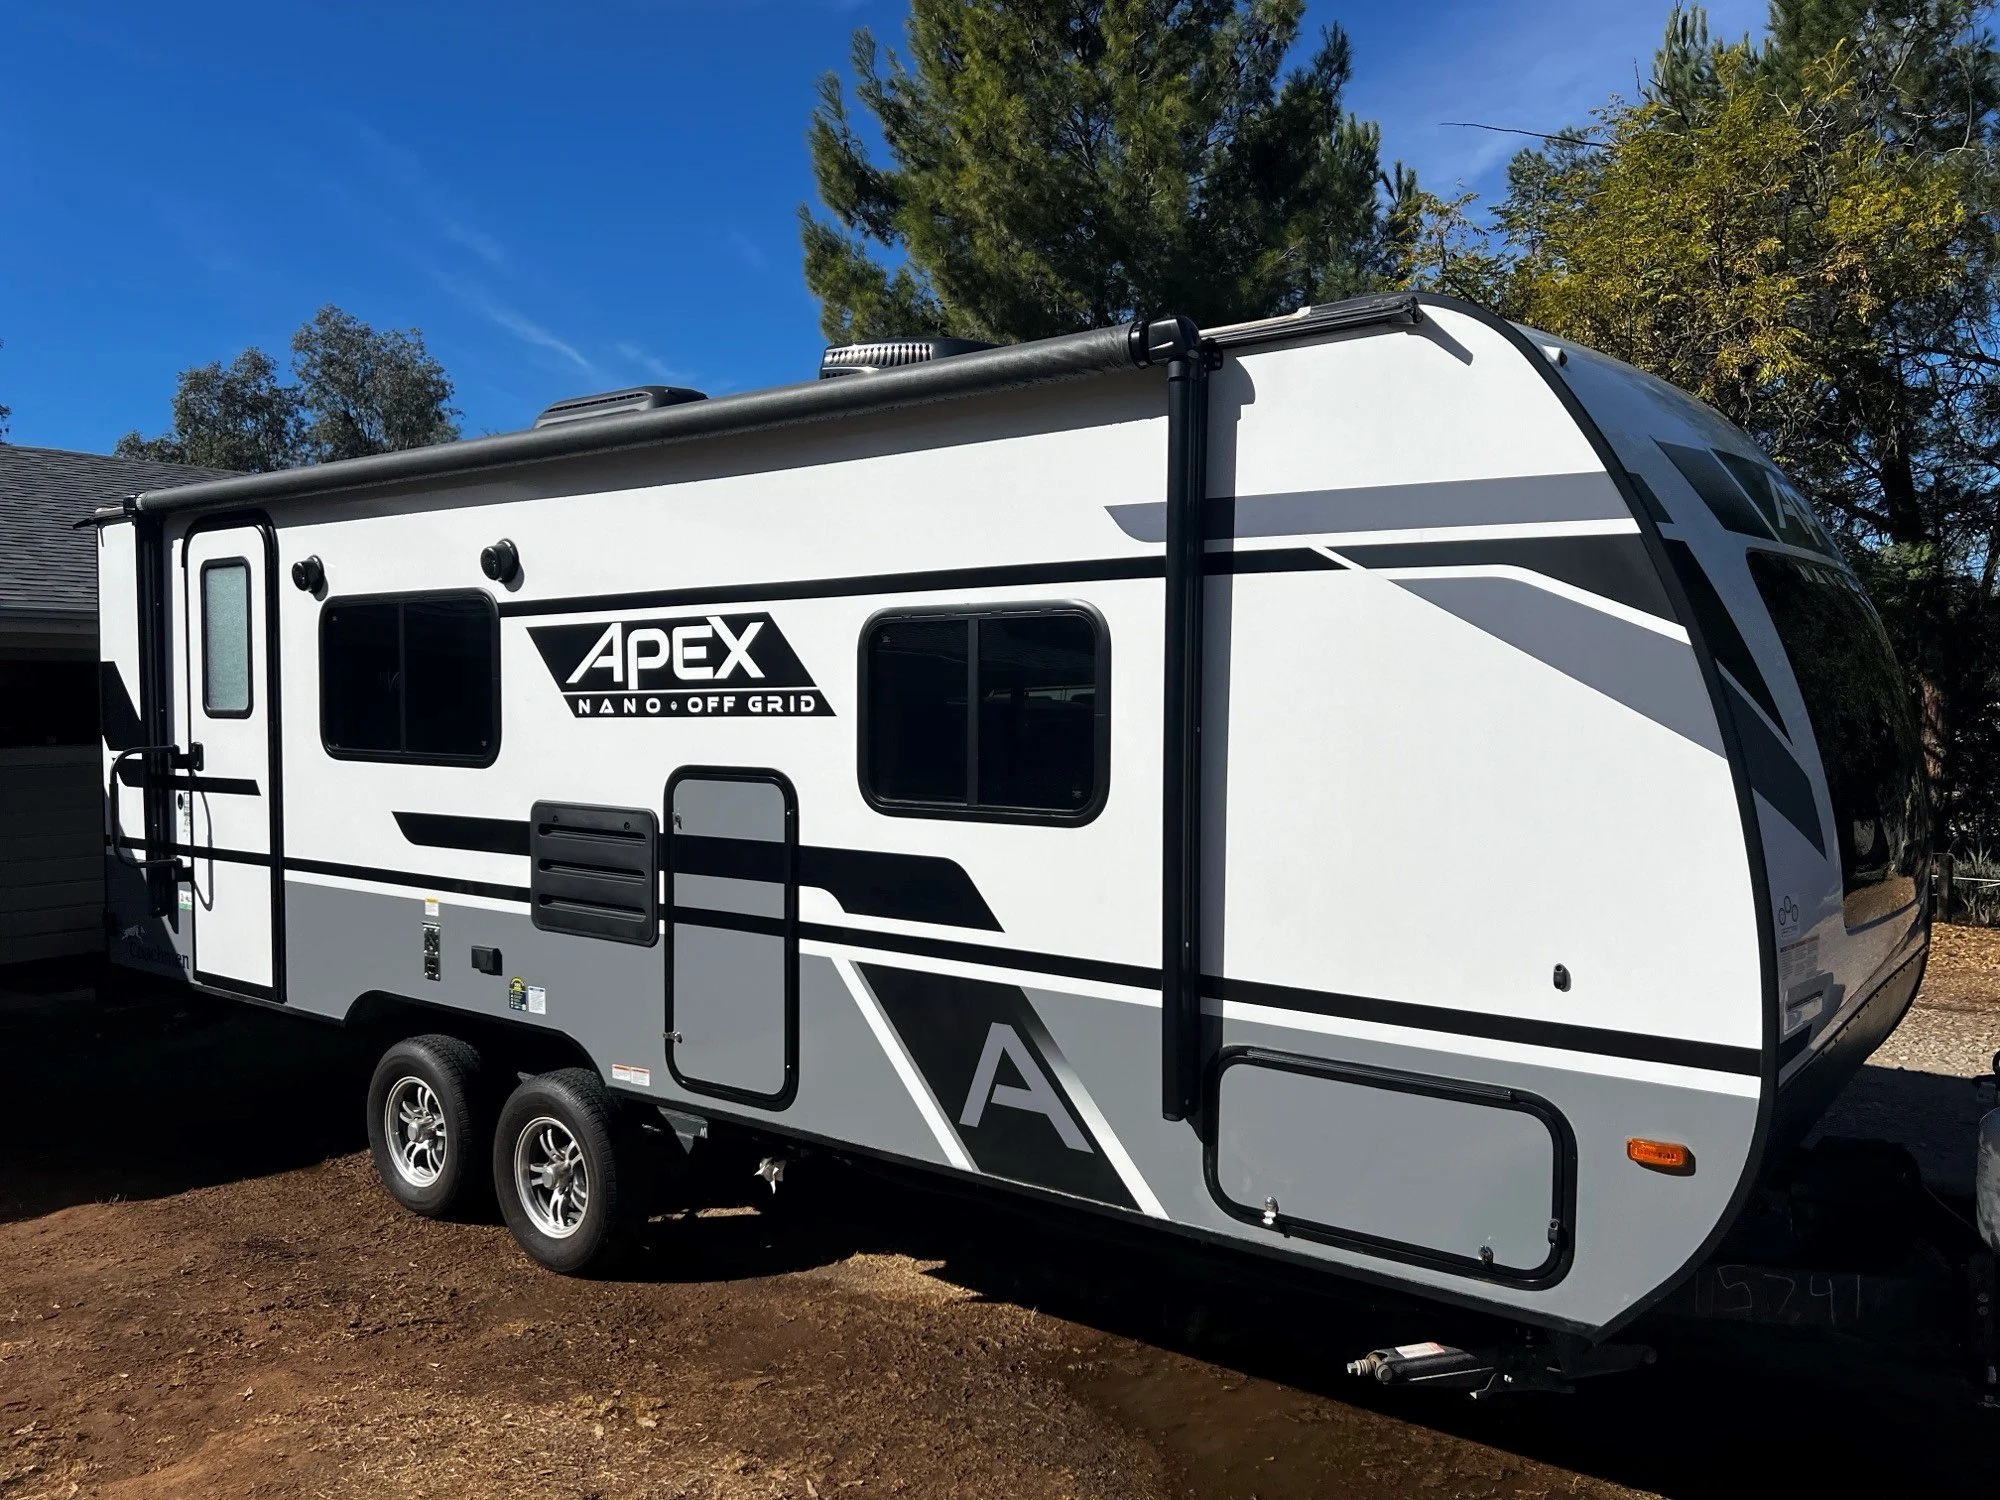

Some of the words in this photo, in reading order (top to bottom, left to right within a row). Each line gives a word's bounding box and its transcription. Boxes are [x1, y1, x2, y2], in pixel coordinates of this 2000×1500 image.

[566, 616, 765, 690] APEX
[577, 698, 661, 714] NANO
[687, 696, 735, 713] OFF
[748, 695, 815, 712] GRID
[959, 1022, 1094, 1154] A
